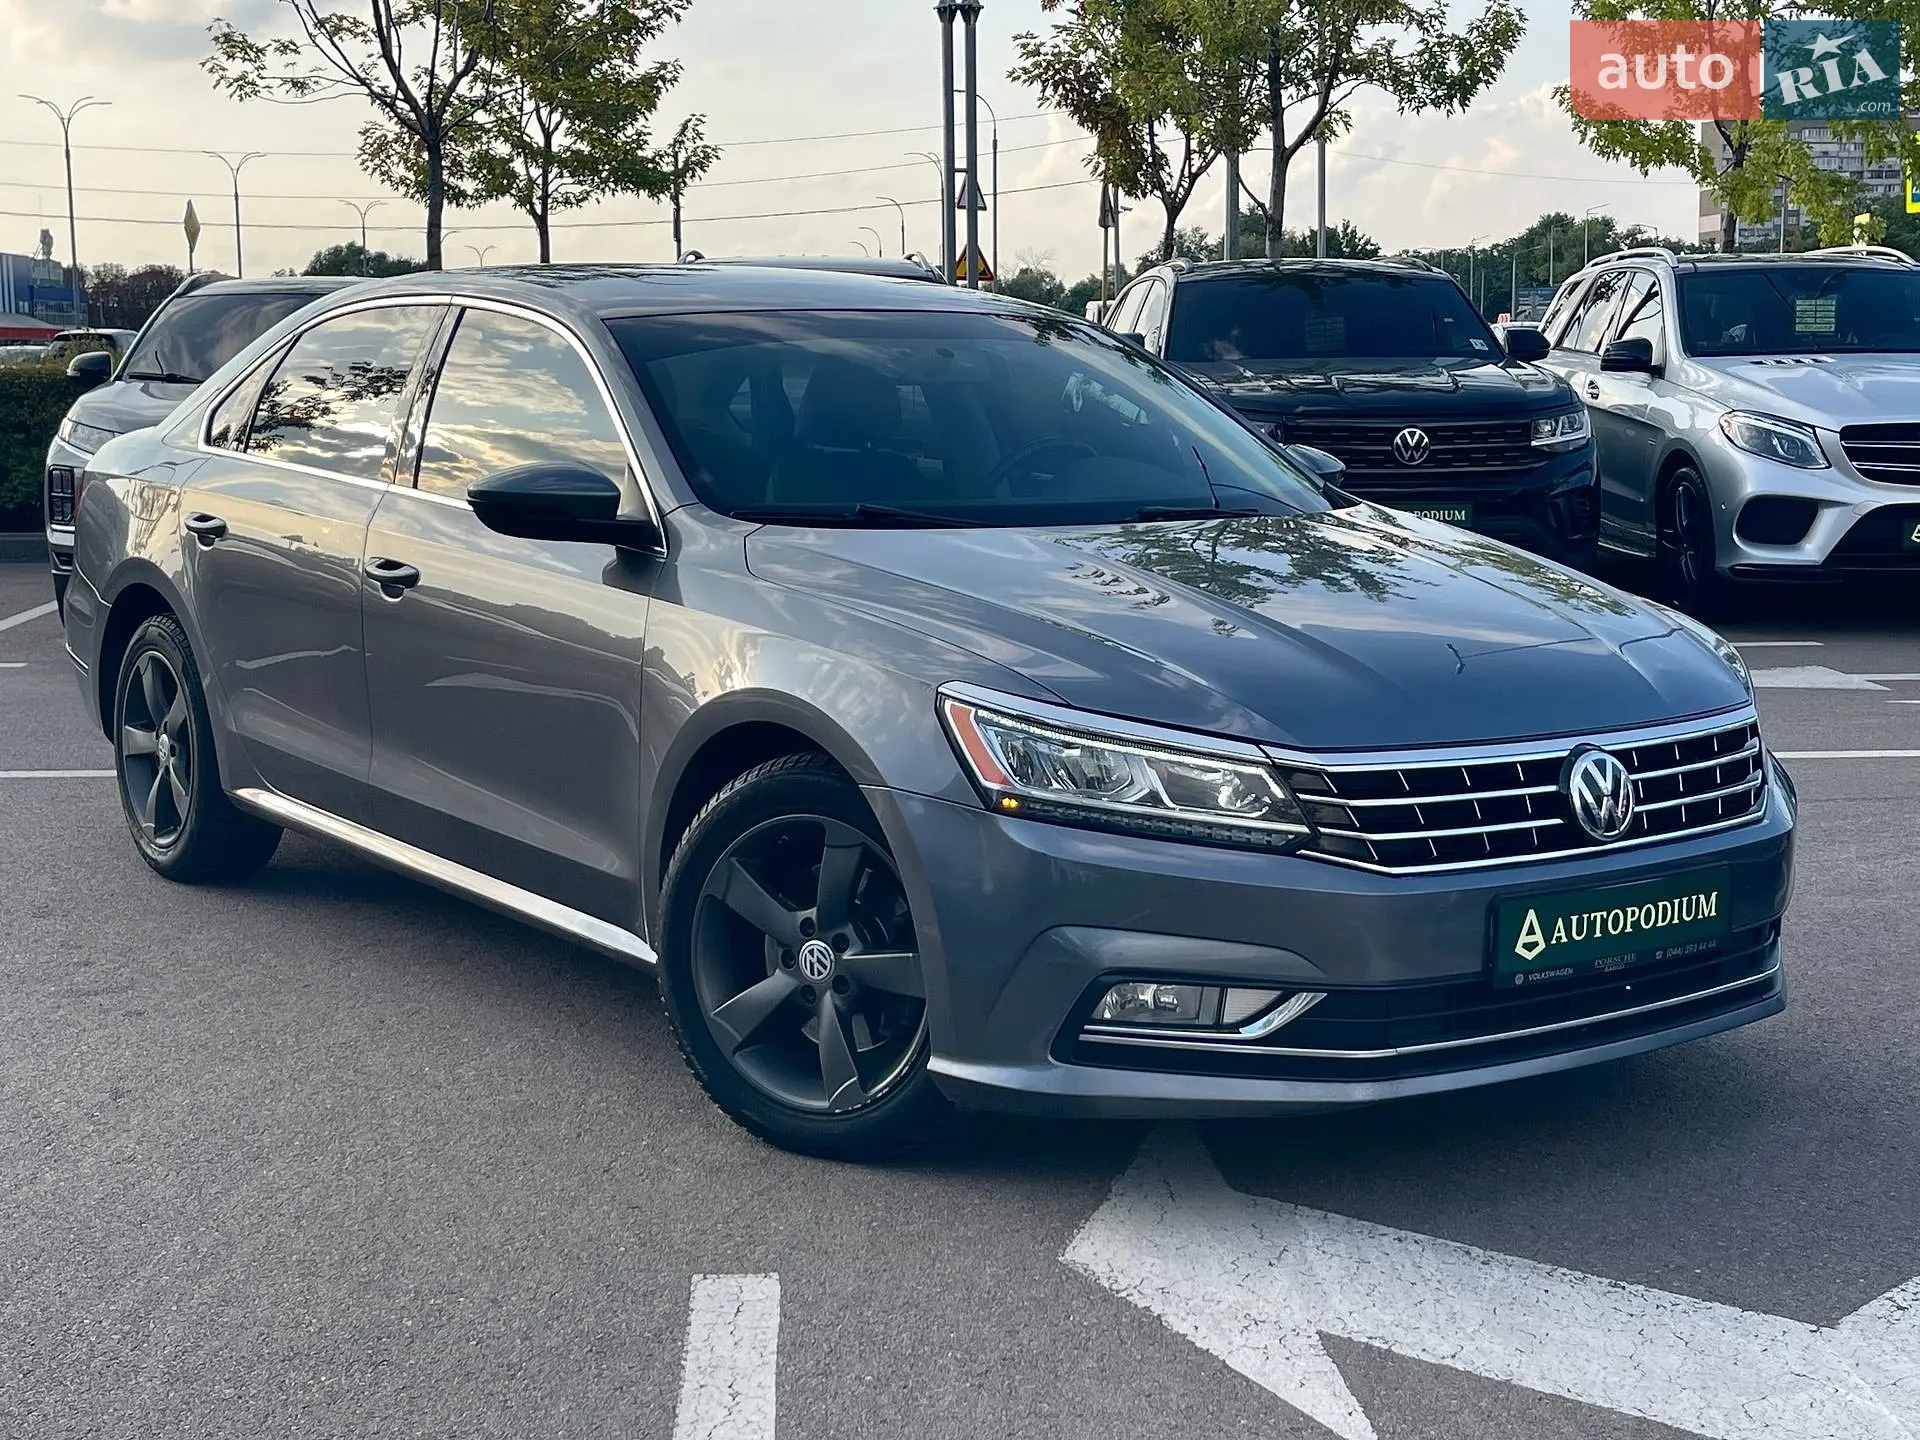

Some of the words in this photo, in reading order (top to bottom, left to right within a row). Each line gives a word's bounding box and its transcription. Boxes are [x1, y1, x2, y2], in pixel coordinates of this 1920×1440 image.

[1411, 509, 1466, 521] PODIUM
[1551, 891, 1718, 944] AUTOPODIUM
[1528, 967, 1574, 981] VOLKSWAGEN
